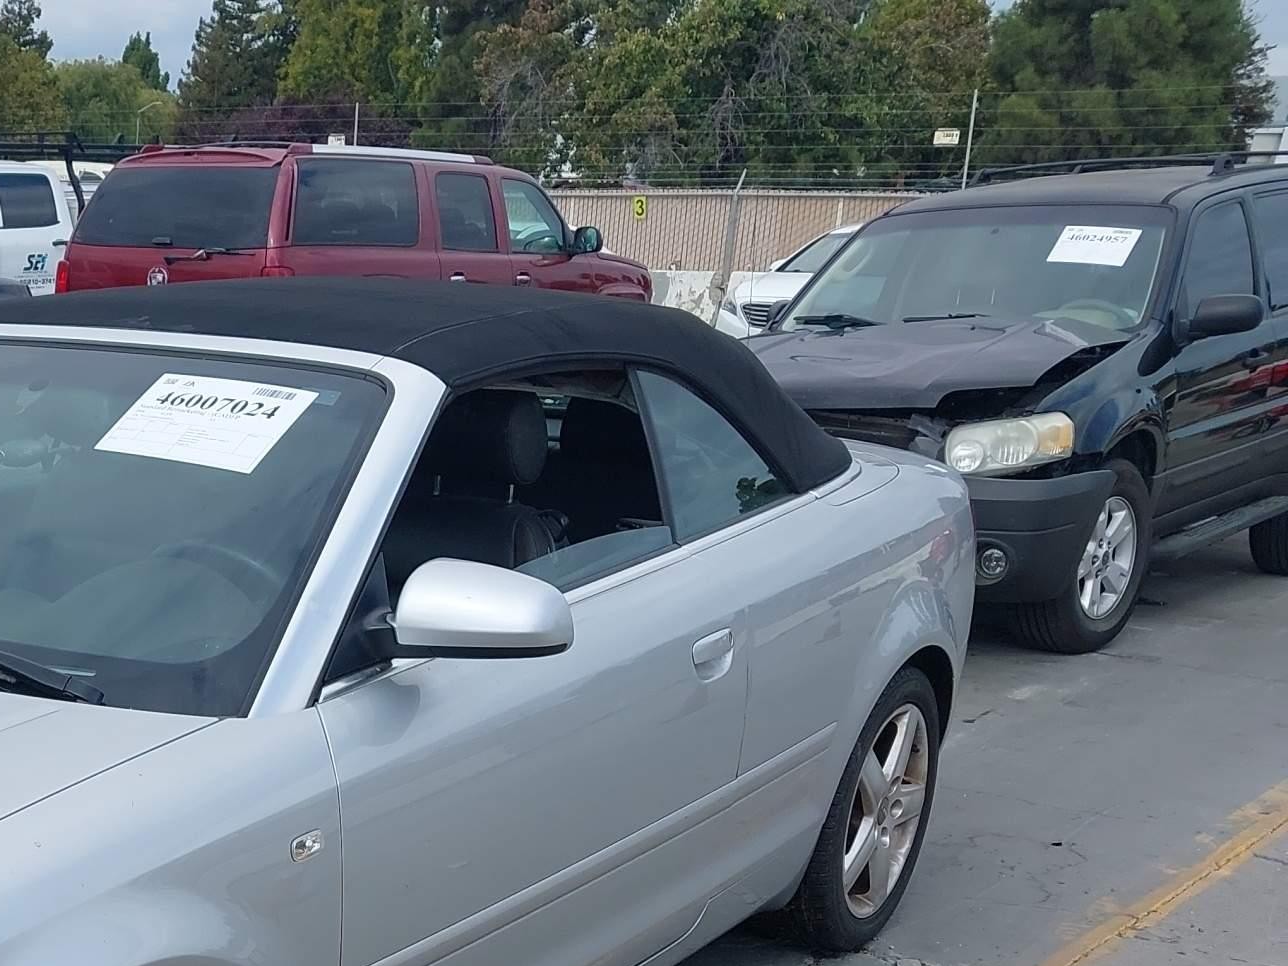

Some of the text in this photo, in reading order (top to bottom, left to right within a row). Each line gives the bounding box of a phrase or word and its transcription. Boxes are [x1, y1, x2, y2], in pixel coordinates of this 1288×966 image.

[635, 199, 645, 217] 3
[1068, 233, 1129, 244] 46024957
[156, 391, 281, 420] 46007024
